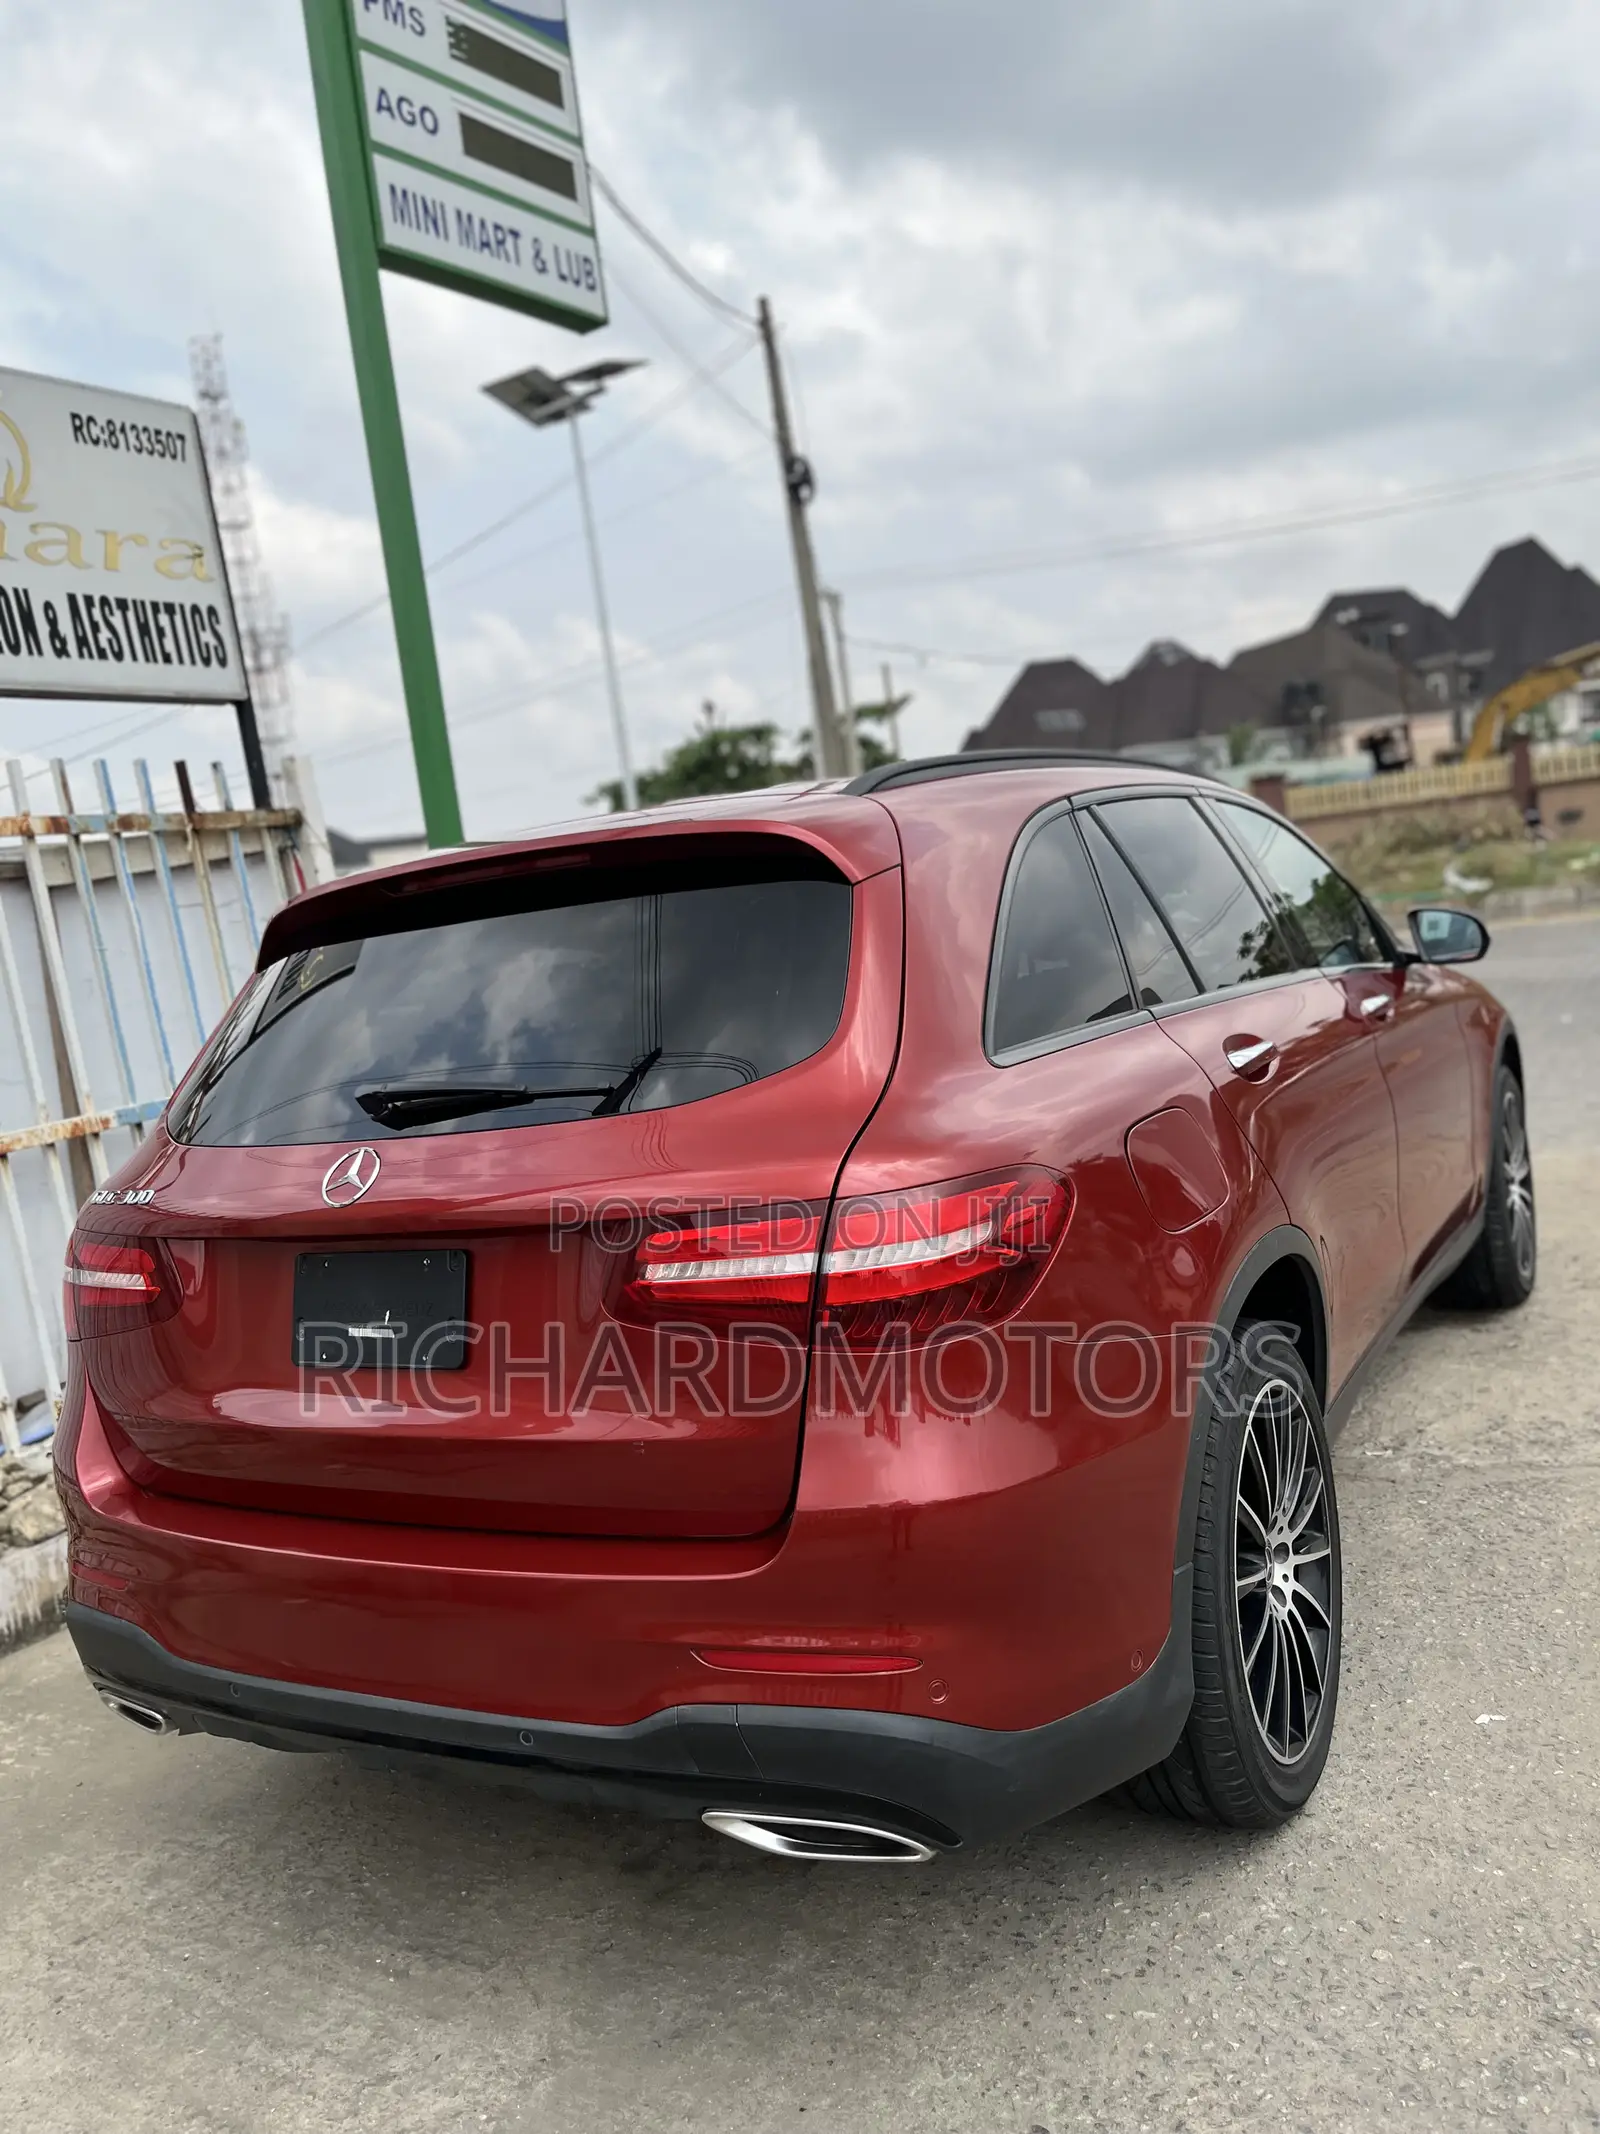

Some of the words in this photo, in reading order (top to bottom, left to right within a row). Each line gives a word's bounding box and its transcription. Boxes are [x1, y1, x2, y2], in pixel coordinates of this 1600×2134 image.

[376, 88, 439, 136] AGO
[389, 184, 449, 242] MINI
[454, 208, 522, 267] MART
[531, 237, 549, 274] &
[553, 245, 597, 293] LUB
[69, 411, 188, 463] RC:8133507
[0, 584, 44, 657] ON
[43, 600, 71, 659] &
[66, 592, 228, 669] AESTHETICS
